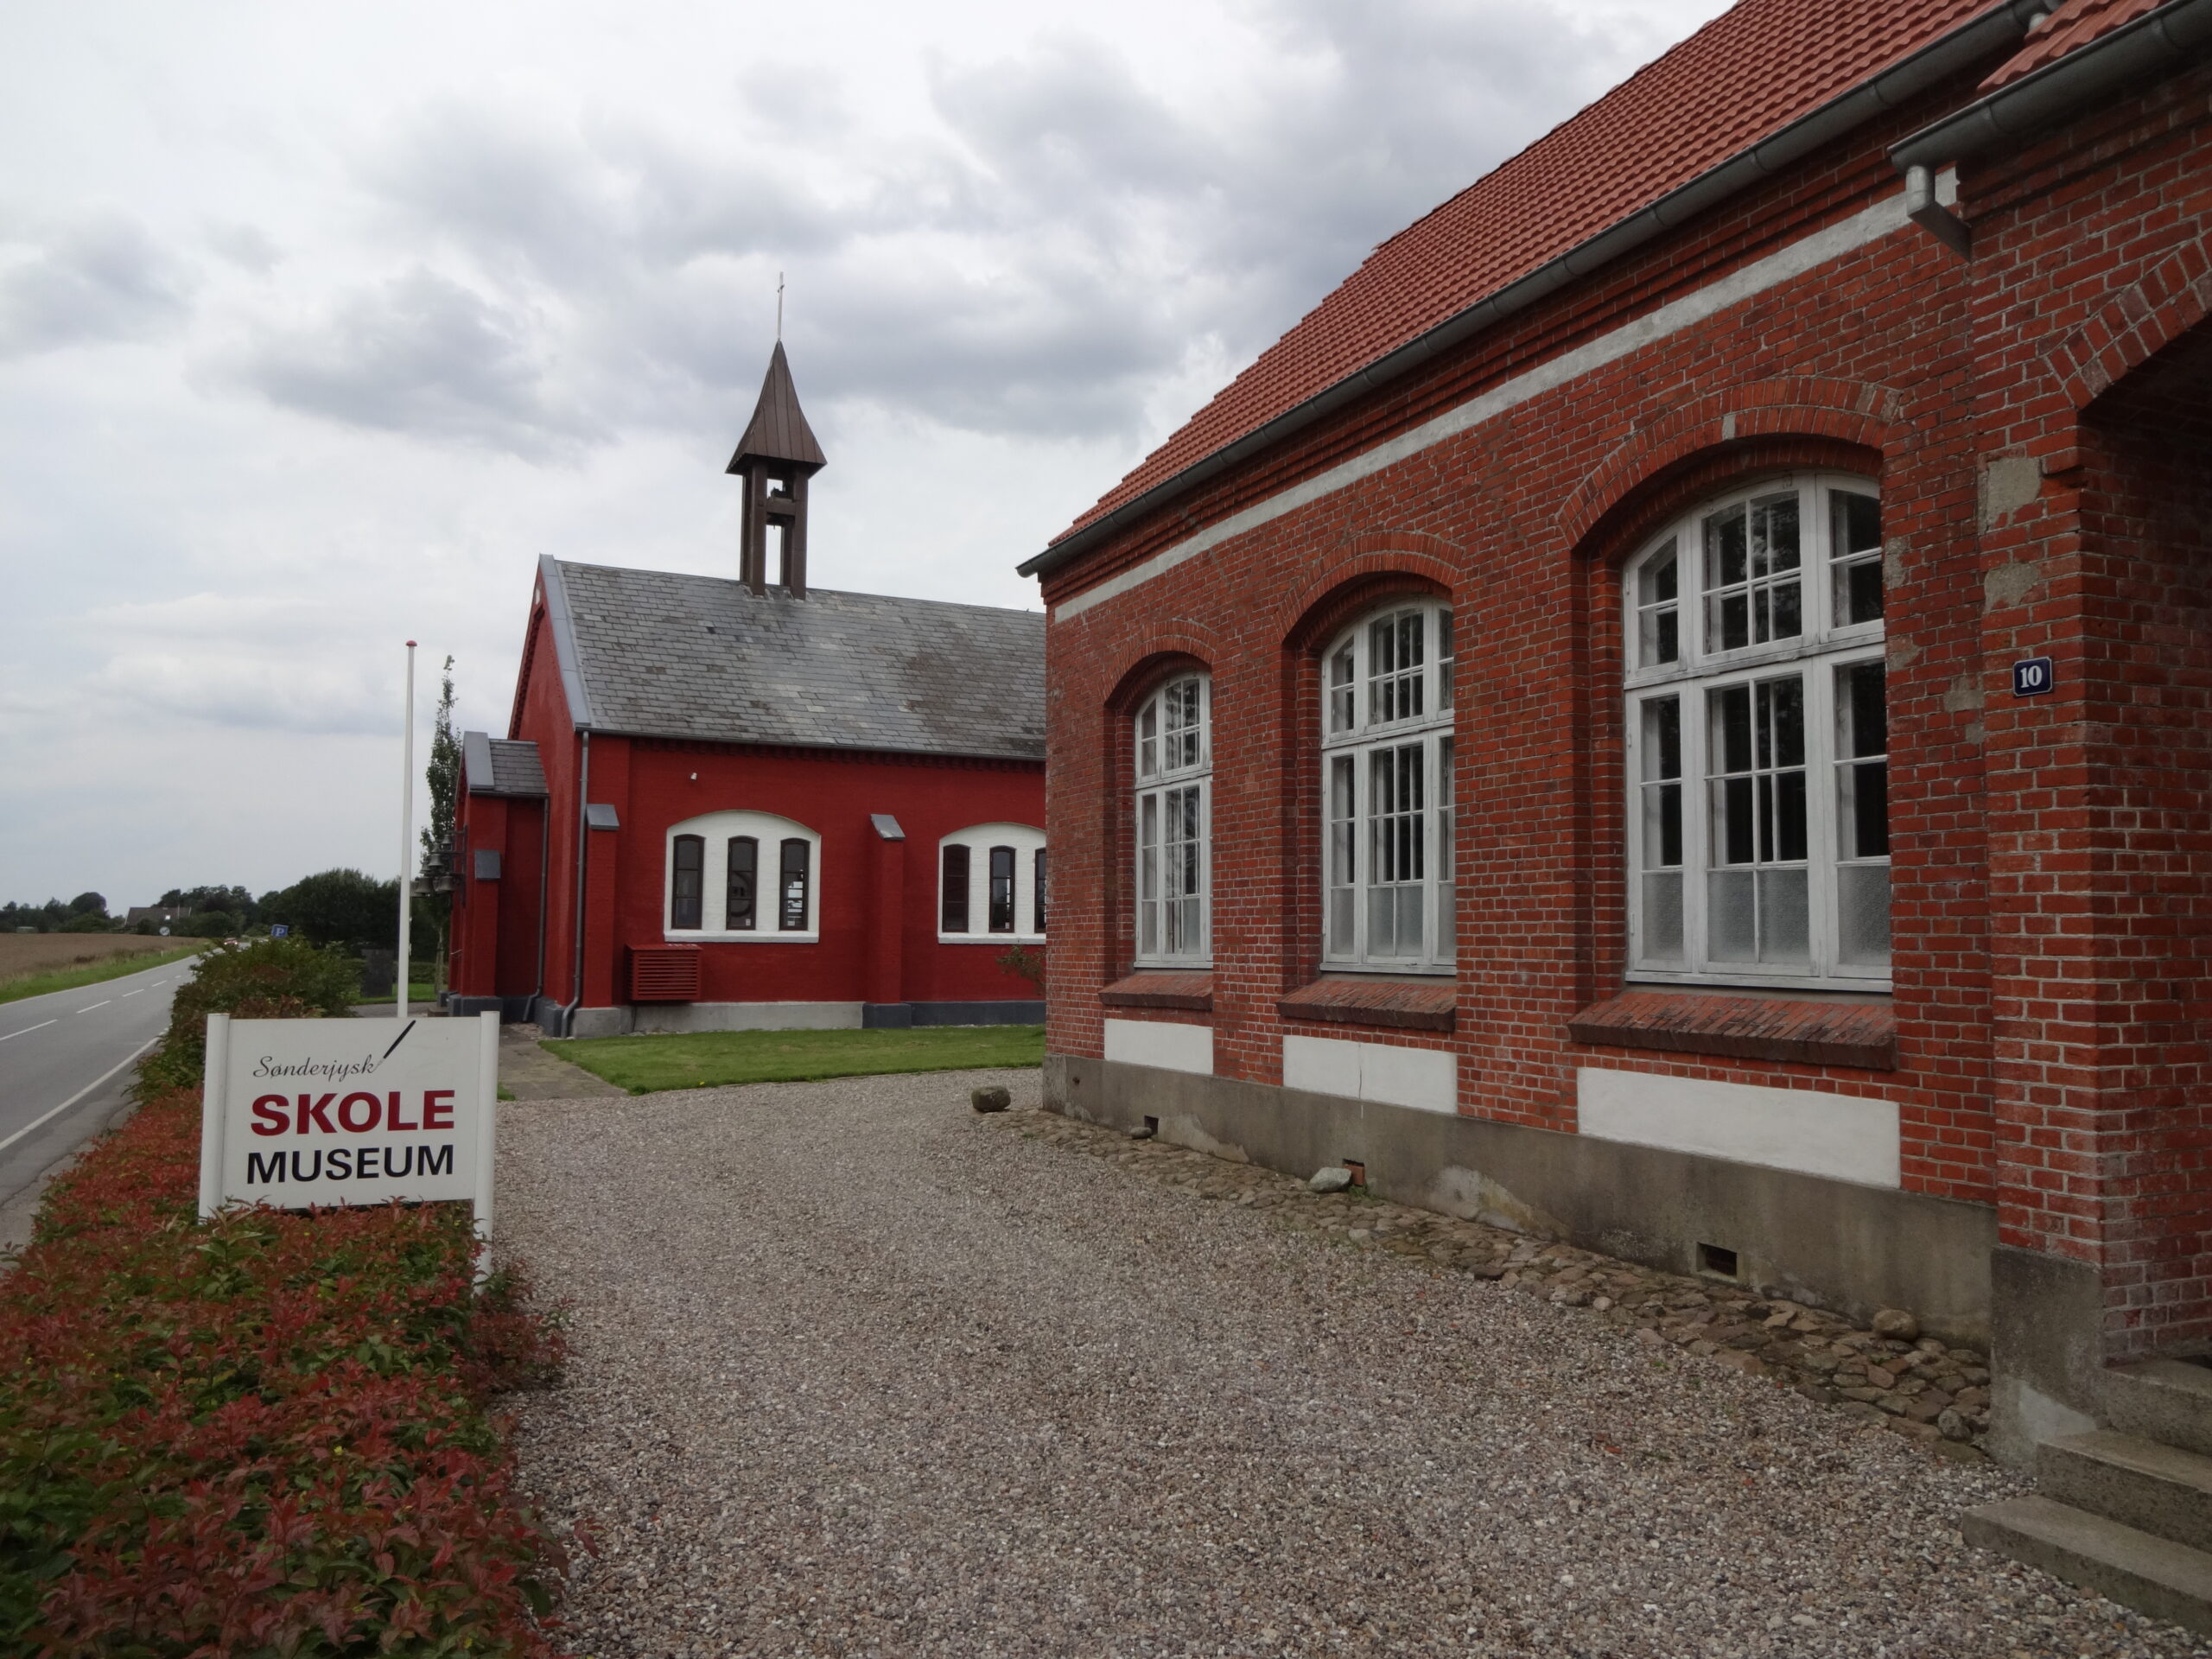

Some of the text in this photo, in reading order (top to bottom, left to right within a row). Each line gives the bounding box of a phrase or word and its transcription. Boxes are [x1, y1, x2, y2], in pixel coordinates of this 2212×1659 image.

[2020, 665, 2043, 689] 10
[276, 927, 285, 938] P
[252, 1053, 377, 1082] Sønderjysk
[251, 1090, 455, 1136] SKOLE
[247, 1145, 454, 1184] MUSEUM
